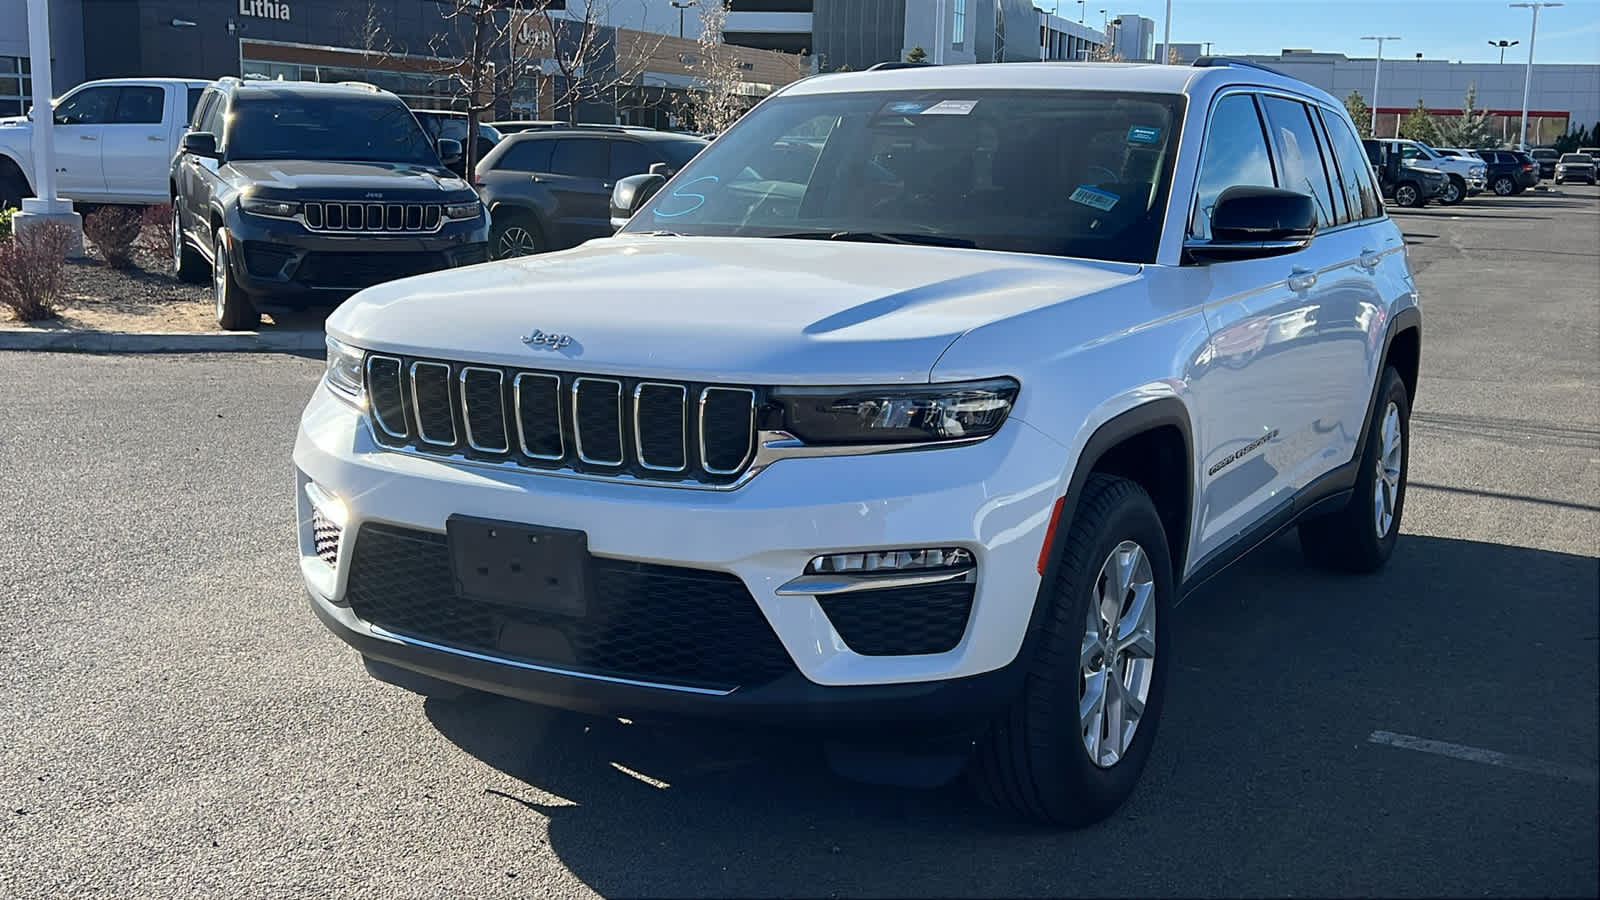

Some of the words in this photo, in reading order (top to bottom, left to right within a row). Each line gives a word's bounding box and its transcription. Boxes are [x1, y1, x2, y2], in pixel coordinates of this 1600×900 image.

[239, 0, 290, 20] Lithia
[518, 22, 551, 49] Jeep
[520, 328, 573, 350] Jeep
